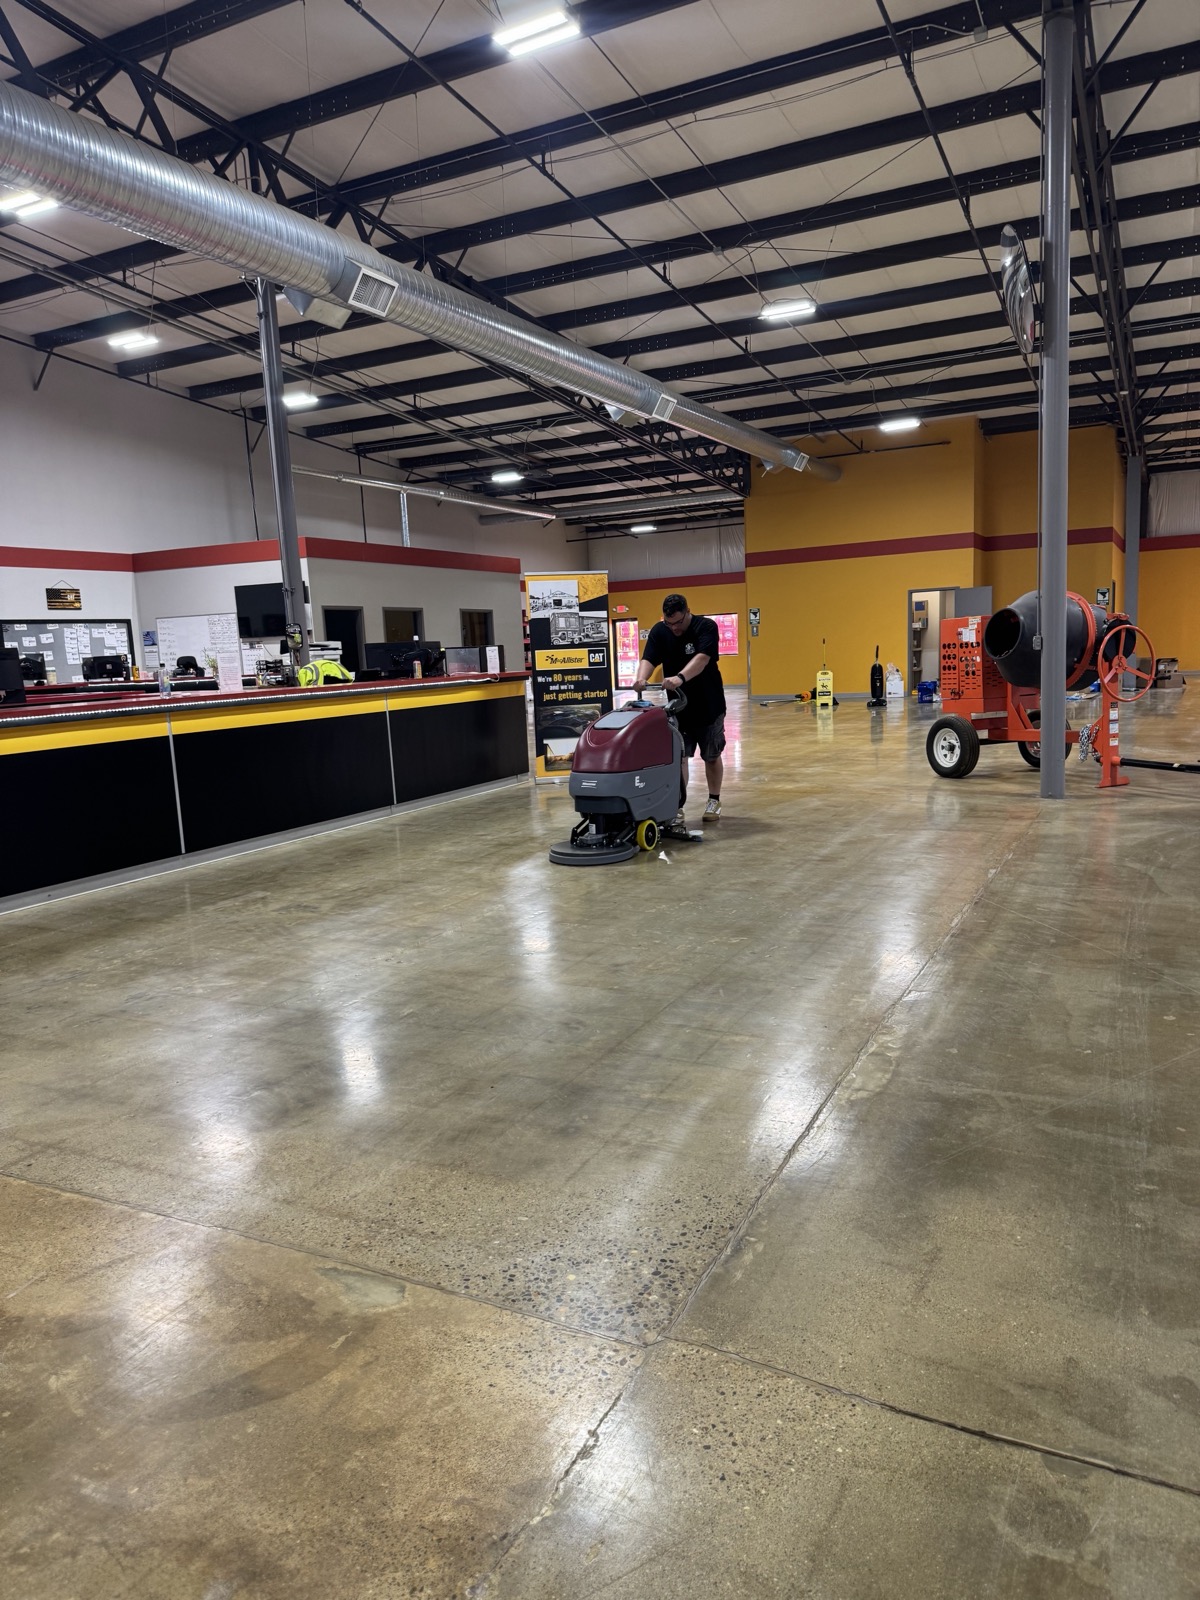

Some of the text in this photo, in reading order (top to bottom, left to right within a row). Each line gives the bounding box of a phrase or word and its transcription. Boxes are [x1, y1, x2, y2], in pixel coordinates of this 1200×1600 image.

[590, 653, 604, 662] CAT
[553, 674, 562, 682] 80
[564, 674, 582, 682] years
[544, 690, 608, 701] just getting started
